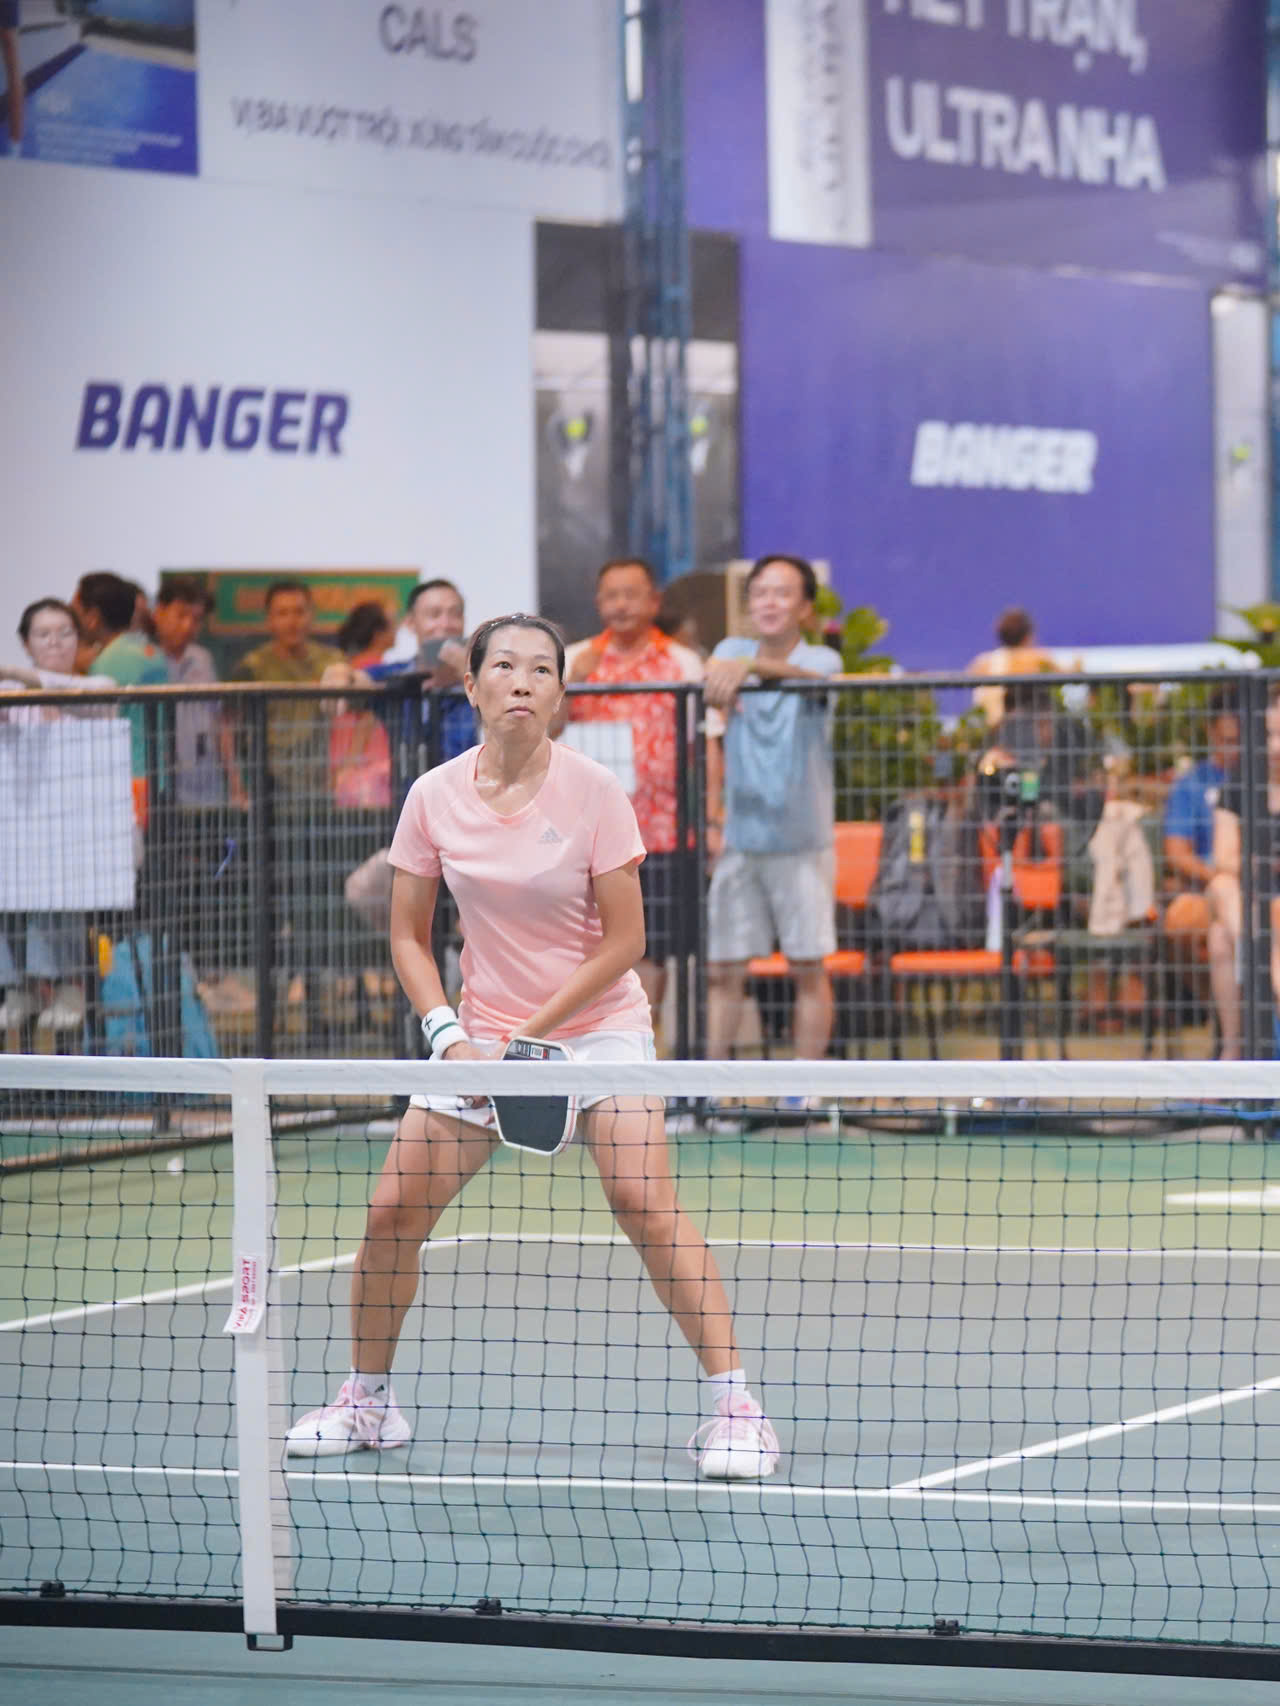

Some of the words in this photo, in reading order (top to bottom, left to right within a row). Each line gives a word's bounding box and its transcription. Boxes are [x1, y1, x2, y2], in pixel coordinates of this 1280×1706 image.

[379, 4, 478, 62] CALS
[77, 380, 349, 454] BANGER
[911, 421, 1097, 493] BANGER
